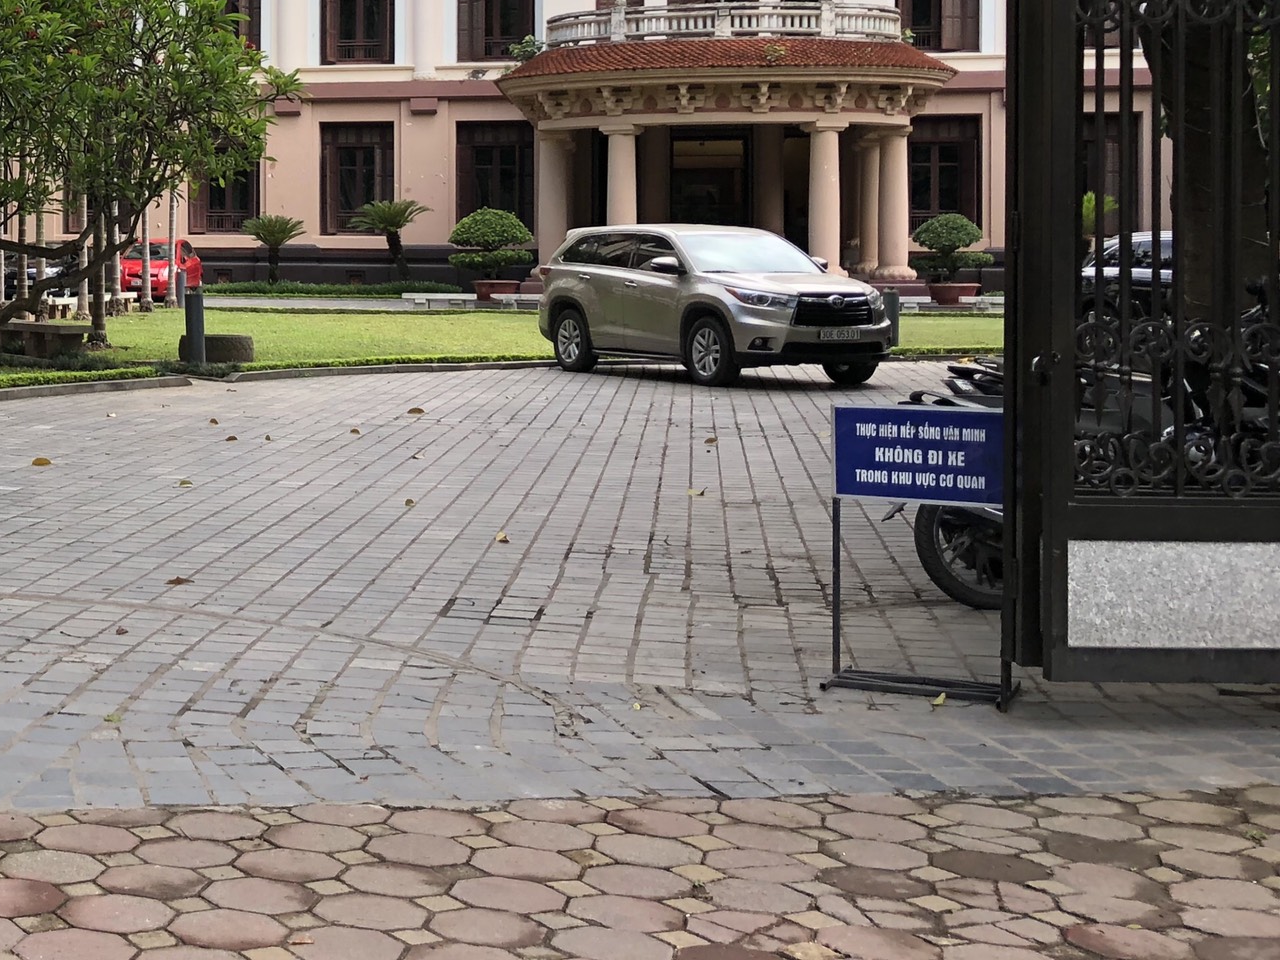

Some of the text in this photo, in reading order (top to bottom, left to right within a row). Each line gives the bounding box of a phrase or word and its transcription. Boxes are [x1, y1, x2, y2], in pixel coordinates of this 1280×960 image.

[856, 421, 985, 442] THỰC HIỆN NẾP SỐNG VĂN MINH
[875, 445, 965, 466] KHÔNG ĐI XE
[856, 469, 985, 489] TRONG KHU VỰC CƠ QUAN
